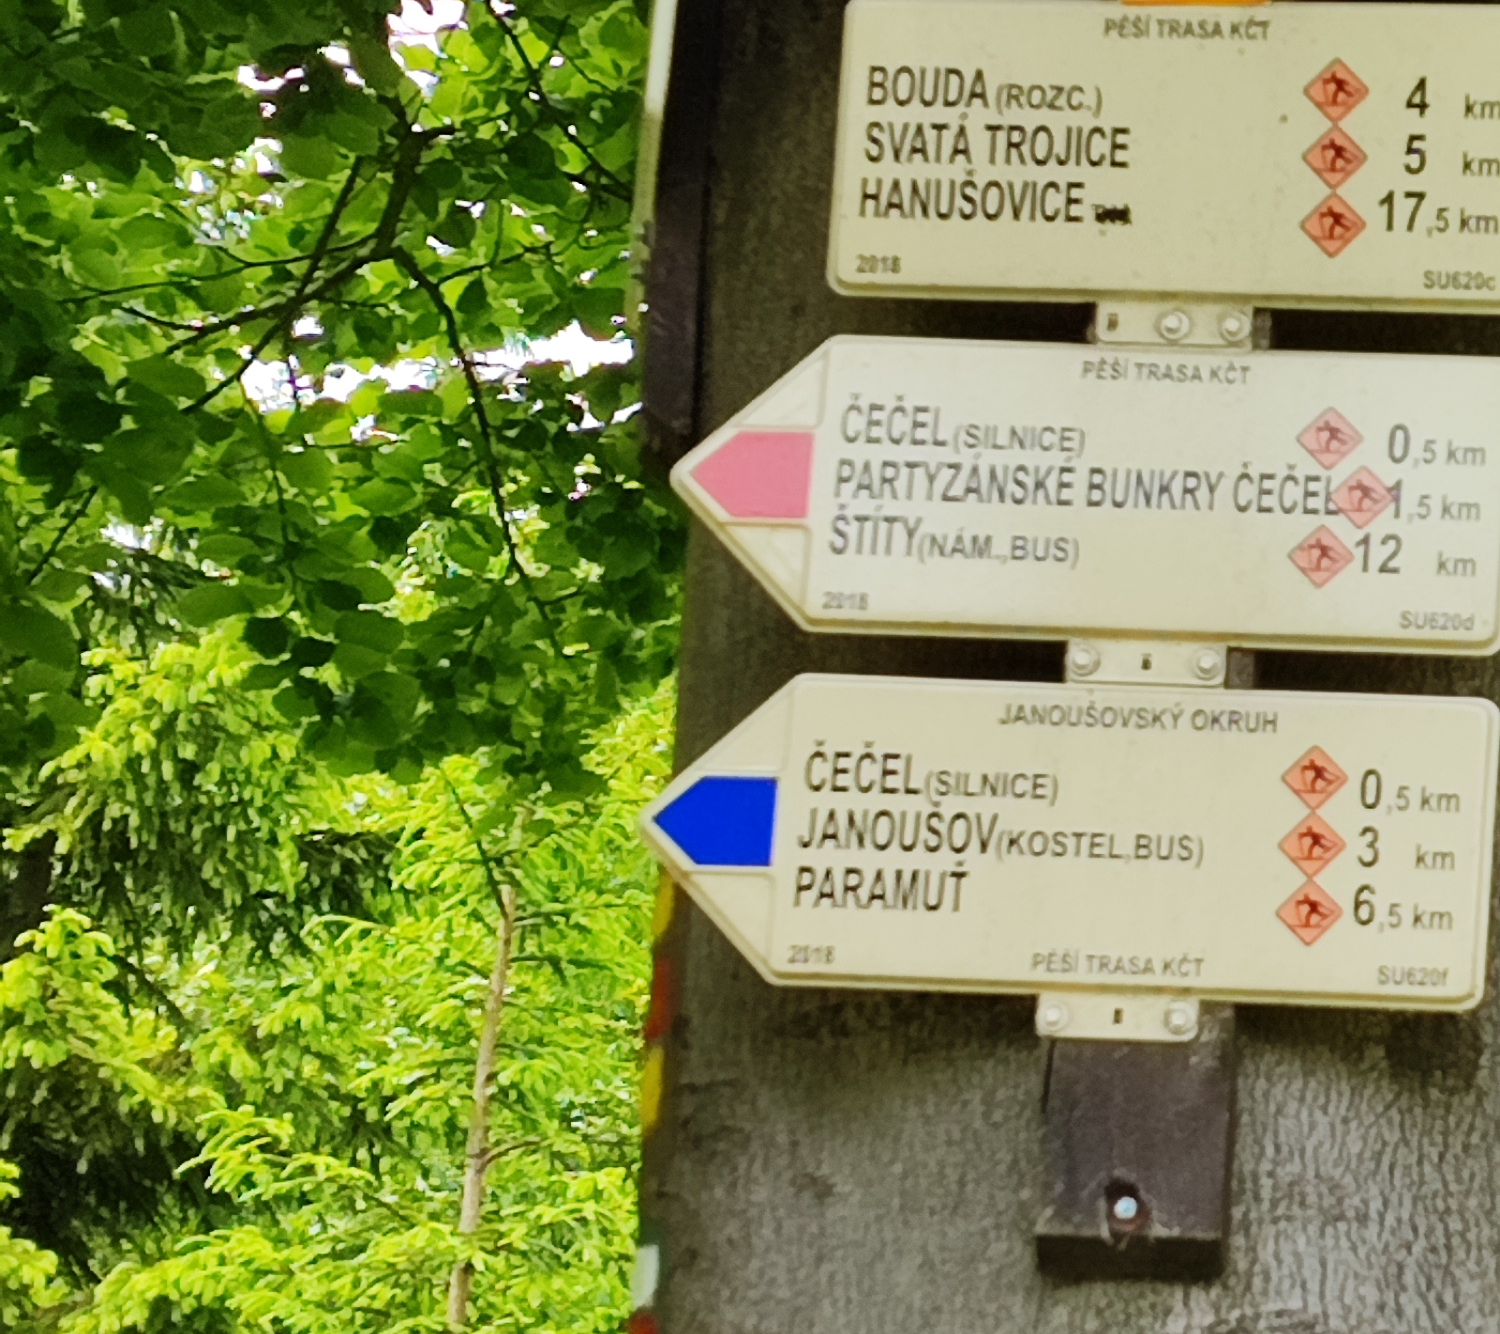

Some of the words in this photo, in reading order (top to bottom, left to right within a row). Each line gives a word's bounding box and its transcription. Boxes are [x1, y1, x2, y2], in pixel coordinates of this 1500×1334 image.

[1103, 13, 1151, 40] PĚŠÍ
[1156, 17, 1225, 40] TRASA
[1229, 15, 1271, 41] KČT
[866, 65, 990, 109] BOUDA
[995, 82, 1103, 120] (ROZC.)
[1405, 75, 1430, 119] 4
[864, 110, 973, 165] SVATÁ
[984, 123, 1131, 168] TROJICE
[1403, 134, 1427, 175] 5
[858, 167, 1086, 223] HANUŠOVICE
[1459, 207, 1499, 235] km
[1081, 357, 1129, 381] PĚŠÍ
[1134, 362, 1203, 383] TRASA
[1209, 360, 1251, 385] KČT
[840, 392, 948, 447] ČEČEL
[952, 423, 1086, 458] (SILNICE)
[1387, 423, 1437, 468] 0,5
[1445, 440, 1486, 466] km
[833, 452, 1076, 507] PARTYZÁNSKÉ
[1086, 467, 1225, 511] BUNKRY
[1232, 461, 1340, 515] ČEČEL
[1441, 495, 1481, 521] km
[828, 502, 923, 556] ŠTÍTY
[1354, 531, 1403, 574] 12
[1436, 551, 1476, 577] km
[998, 699, 1185, 730] JANOUŠOVSKÝ
[1190, 709, 1279, 734] OKRUH
[804, 739, 922, 795] ČEČEL
[923, 769, 1059, 807] (SILNICE)
[1360, 768, 1410, 815] 0,5
[1420, 785, 1461, 813] km
[797, 801, 999, 854] JANOUŠOV
[1357, 825, 1380, 868] 3
[1415, 844, 1456, 870] km
[1353, 883, 1402, 934] 6,5
[1412, 903, 1453, 930] km
[1031, 949, 1080, 974] PĚŠÍ
[1086, 954, 1155, 975] TRASA
[1162, 953, 1206, 978] KČT
